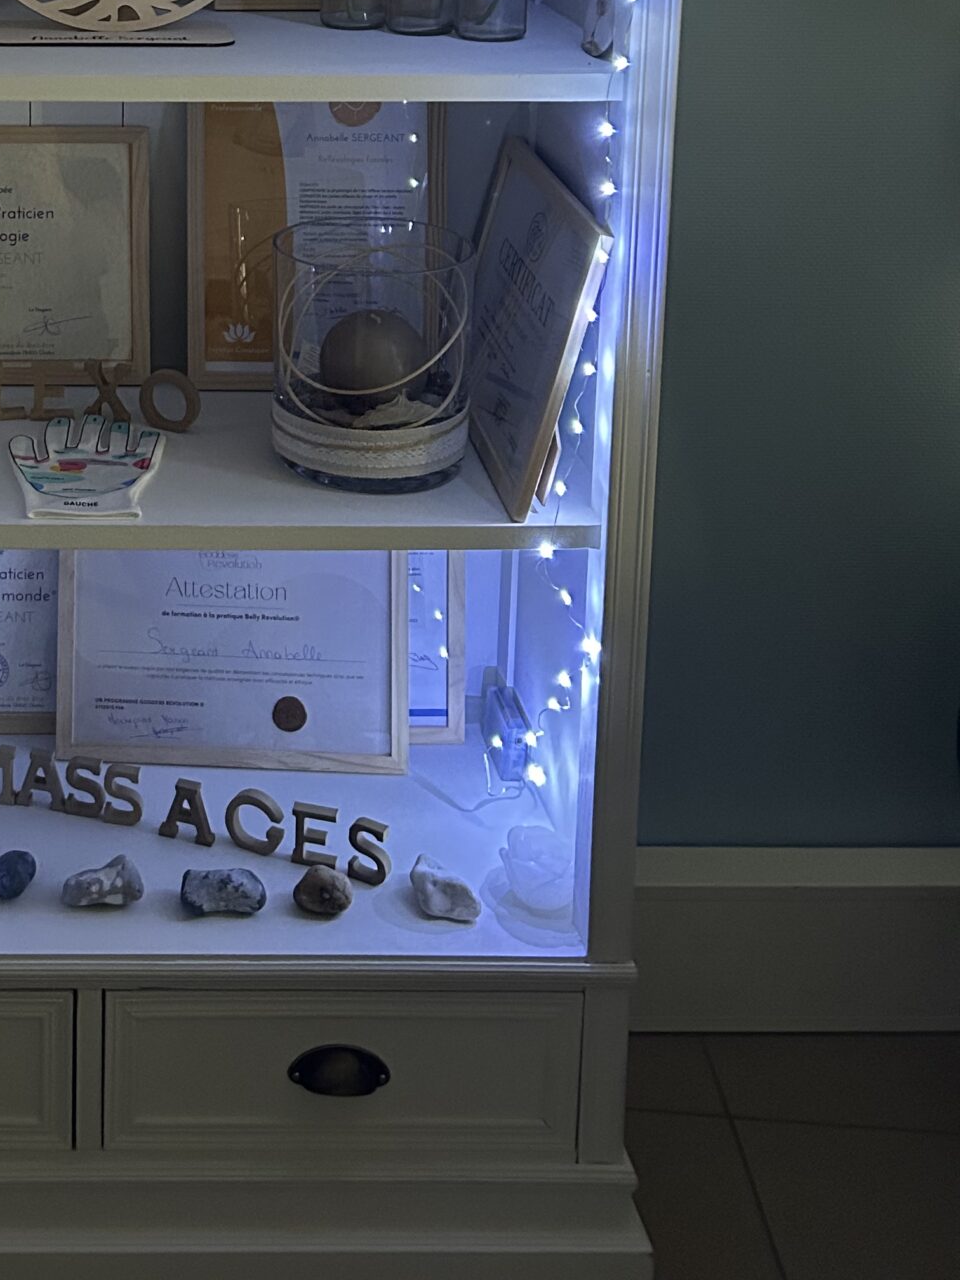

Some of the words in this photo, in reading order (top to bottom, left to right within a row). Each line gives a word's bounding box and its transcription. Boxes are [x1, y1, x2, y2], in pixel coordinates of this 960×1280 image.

[306, 132, 349, 142] Annabelle
[351, 132, 406, 143] SERGEANT
[165, 576, 287, 601] Attestation
[171, 610, 202, 618] formation
[216, 612, 244, 620] pratique
